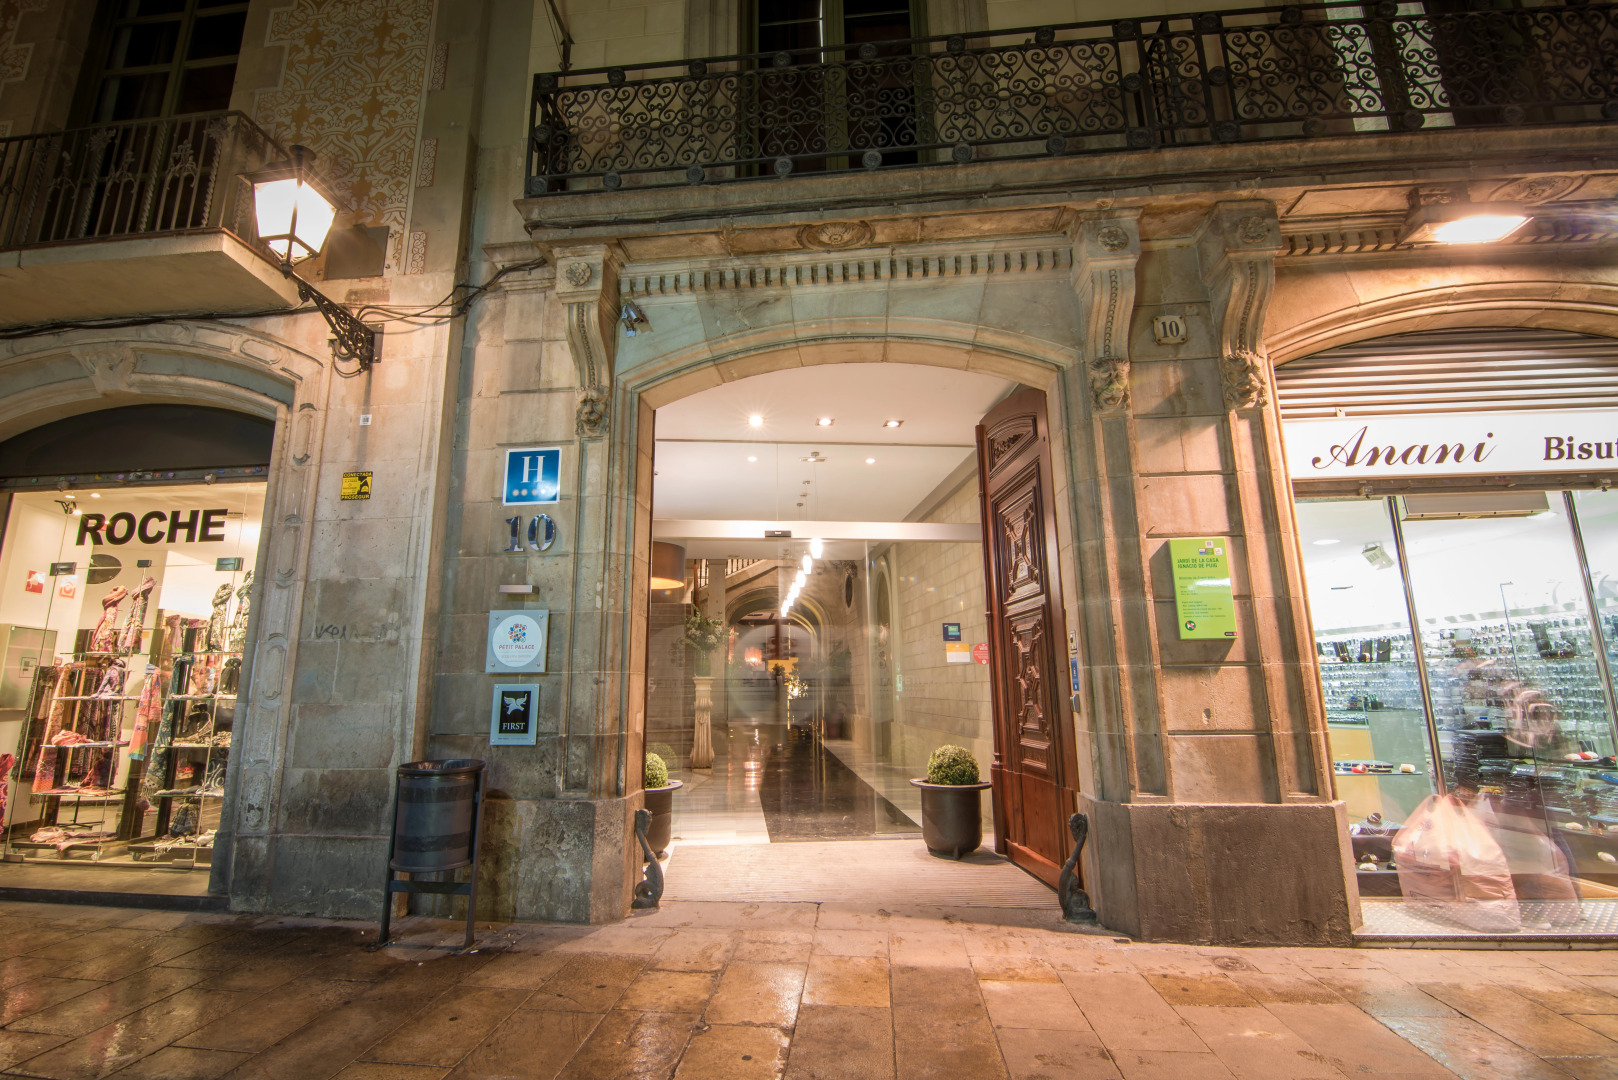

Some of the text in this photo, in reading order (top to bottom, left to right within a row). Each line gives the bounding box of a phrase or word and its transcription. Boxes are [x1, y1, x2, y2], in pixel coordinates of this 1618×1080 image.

[1161, 320, 1180, 338] 10
[1311, 426, 1498, 469] Anani
[520, 455, 546, 483] H
[75, 508, 228, 546] ROCHE
[503, 513, 556, 553] 10
[502, 722, 526, 730] FIRST
